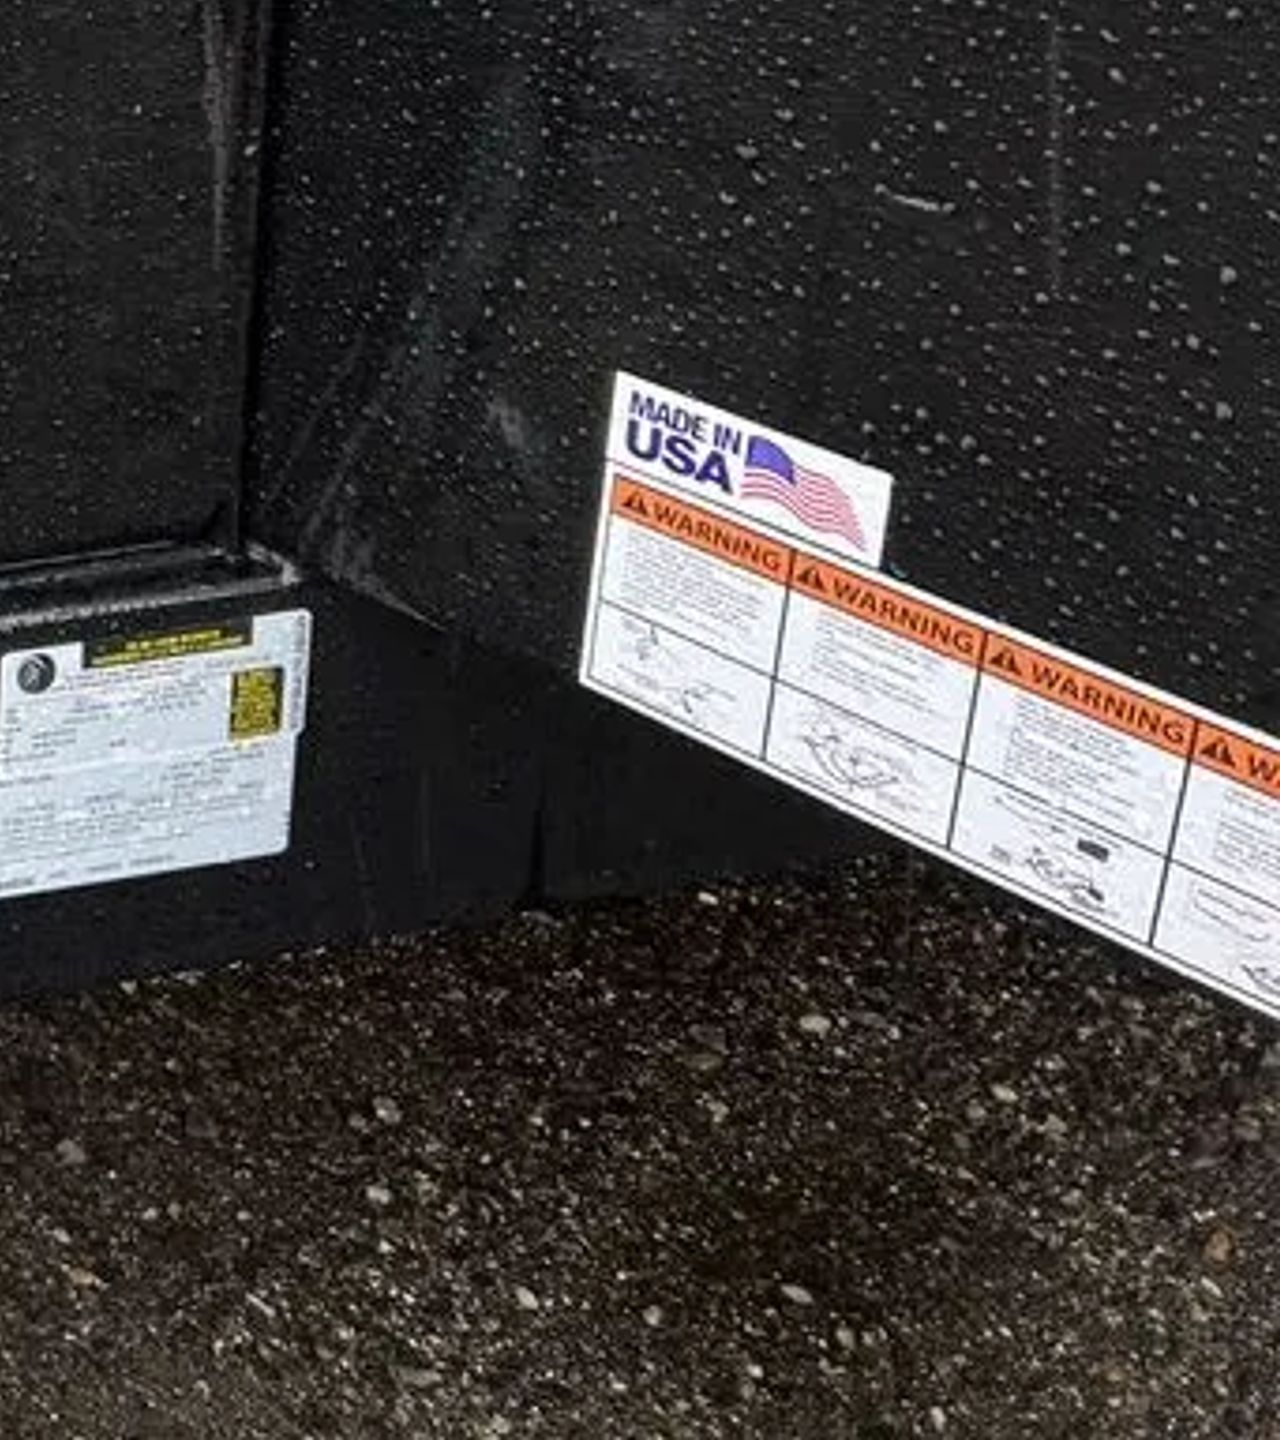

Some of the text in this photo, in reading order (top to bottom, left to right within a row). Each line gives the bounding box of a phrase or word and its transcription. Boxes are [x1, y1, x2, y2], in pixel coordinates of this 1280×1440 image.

[626, 419, 735, 496] USA
[630, 390, 743, 455] MADE IN
[653, 502, 781, 572] WARNING
[833, 578, 975, 656] WARNING
[1031, 663, 1185, 745] WARNING
